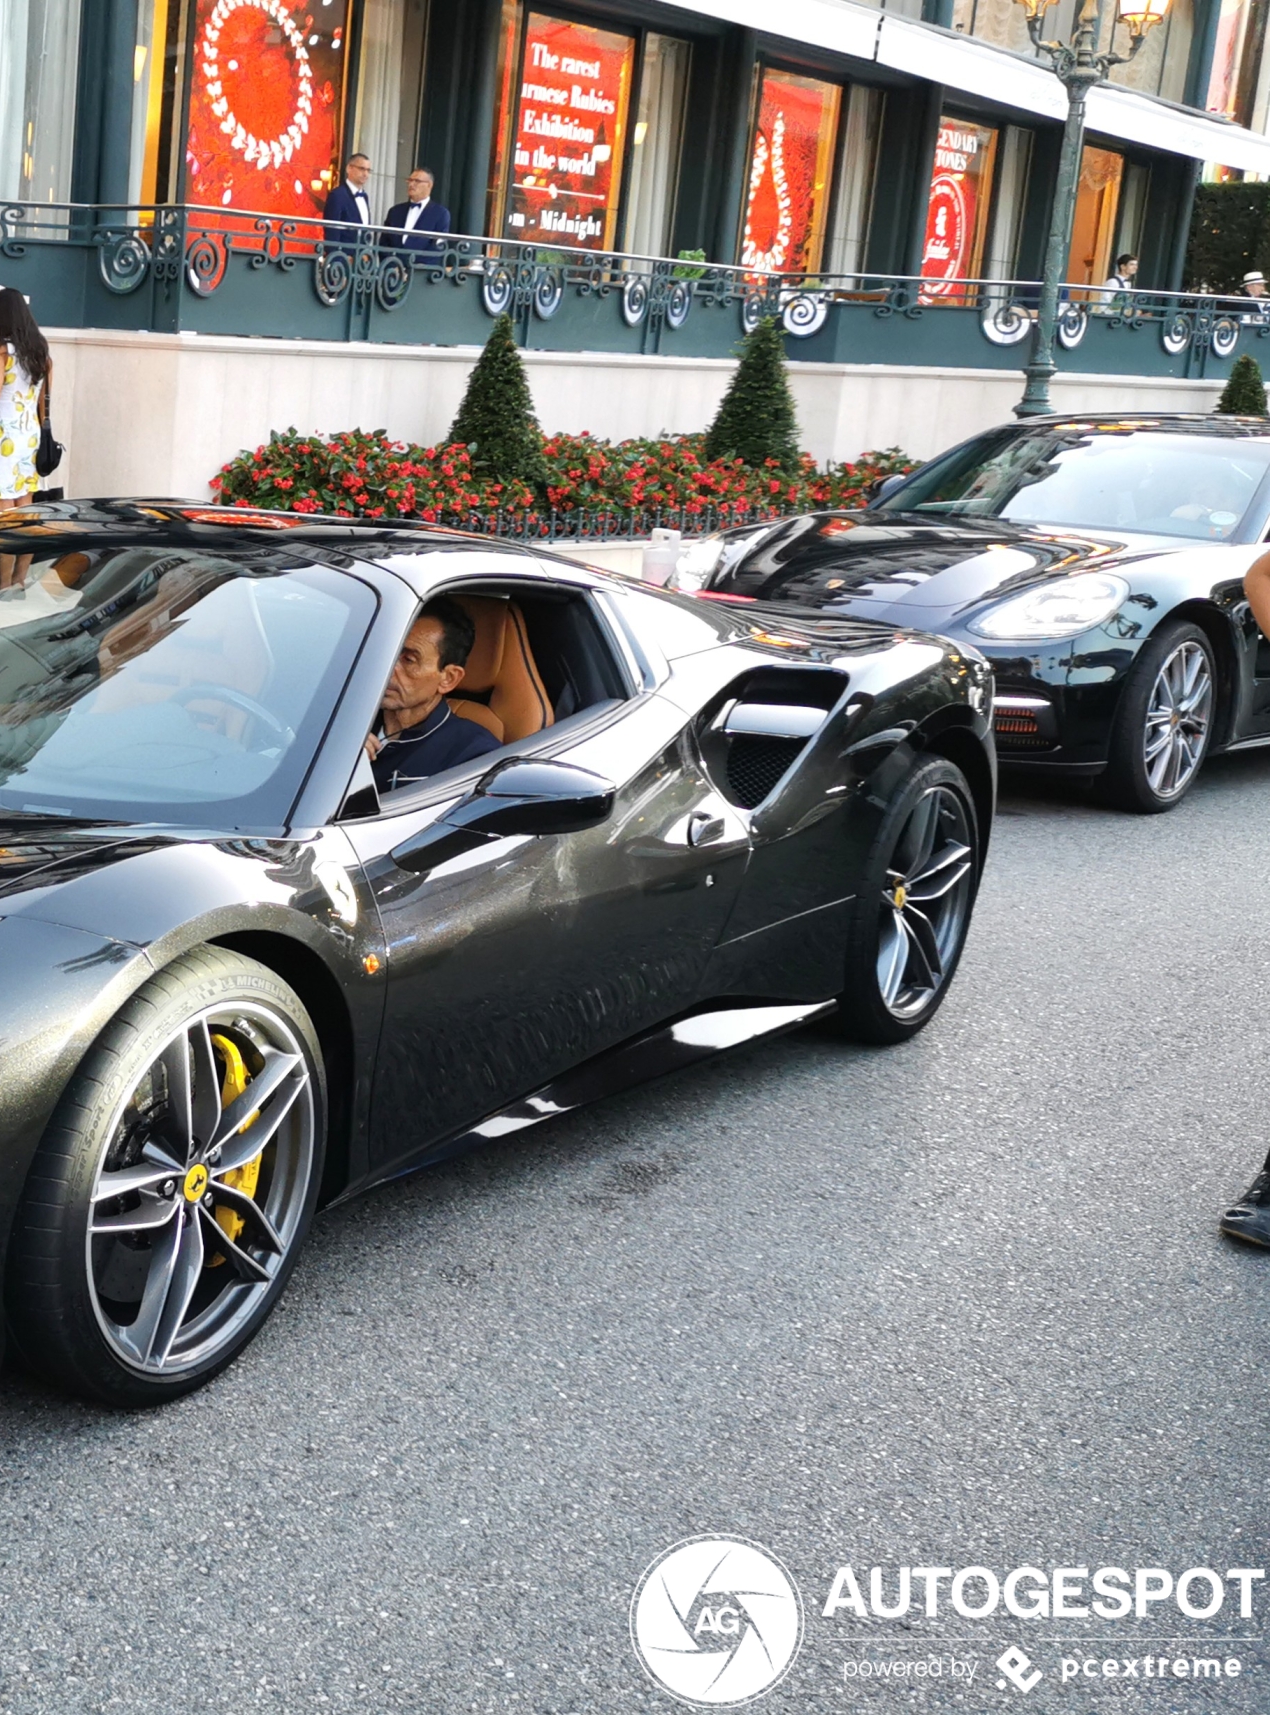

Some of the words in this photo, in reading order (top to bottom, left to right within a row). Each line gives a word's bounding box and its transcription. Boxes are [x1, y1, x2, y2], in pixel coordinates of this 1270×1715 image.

[532, 42, 559, 70] The
[560, 57, 600, 79] rarest
[569, 84, 616, 115] Rubies
[523, 109, 594, 143] Exhibition
[514, 142, 530, 166] in
[532, 146, 556, 170] the
[558, 152, 597, 176] world
[539, 210, 602, 241] Midnight
